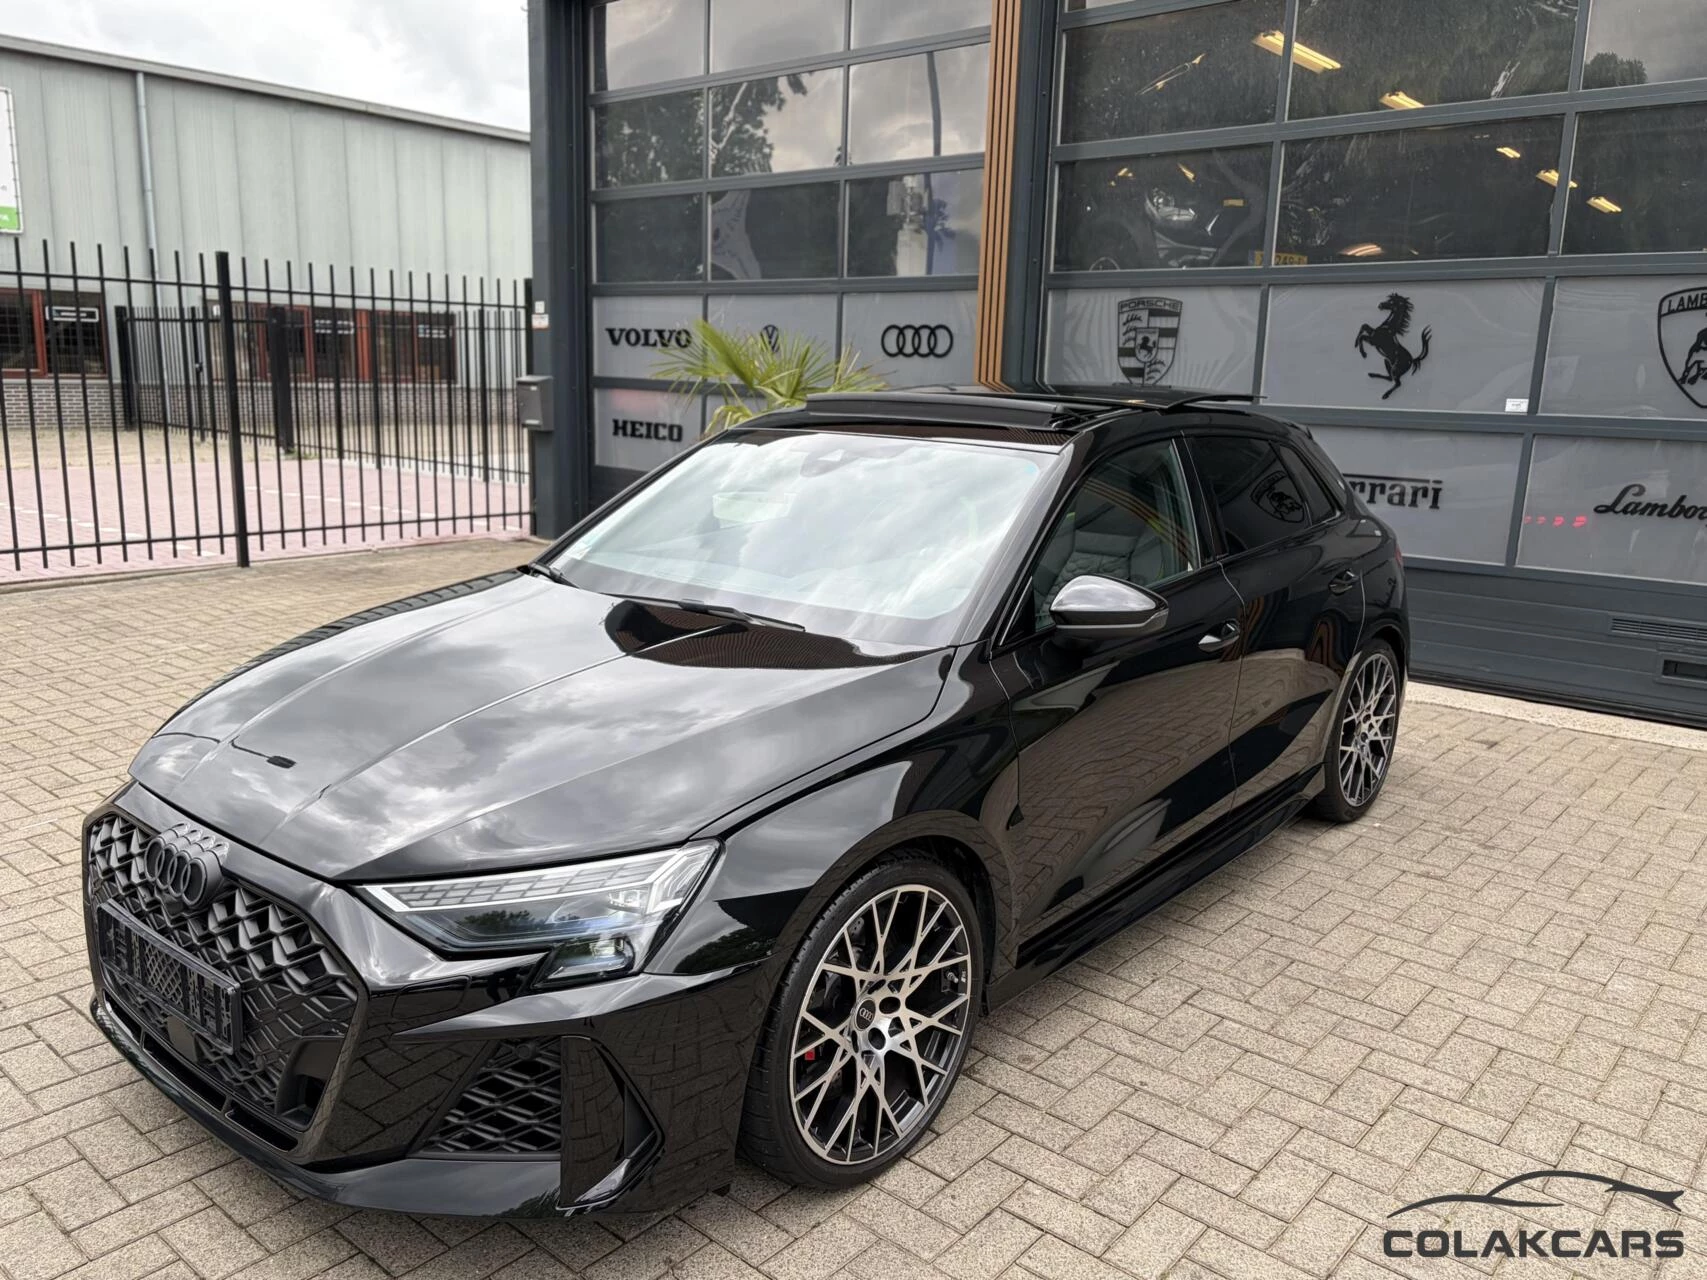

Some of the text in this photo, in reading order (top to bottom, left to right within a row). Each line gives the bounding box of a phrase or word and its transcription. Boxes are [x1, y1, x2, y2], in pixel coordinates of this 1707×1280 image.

[605, 327, 693, 349] VOLVO
[612, 418, 683, 443] HEICO
[1343, 473, 1443, 510] rrari
